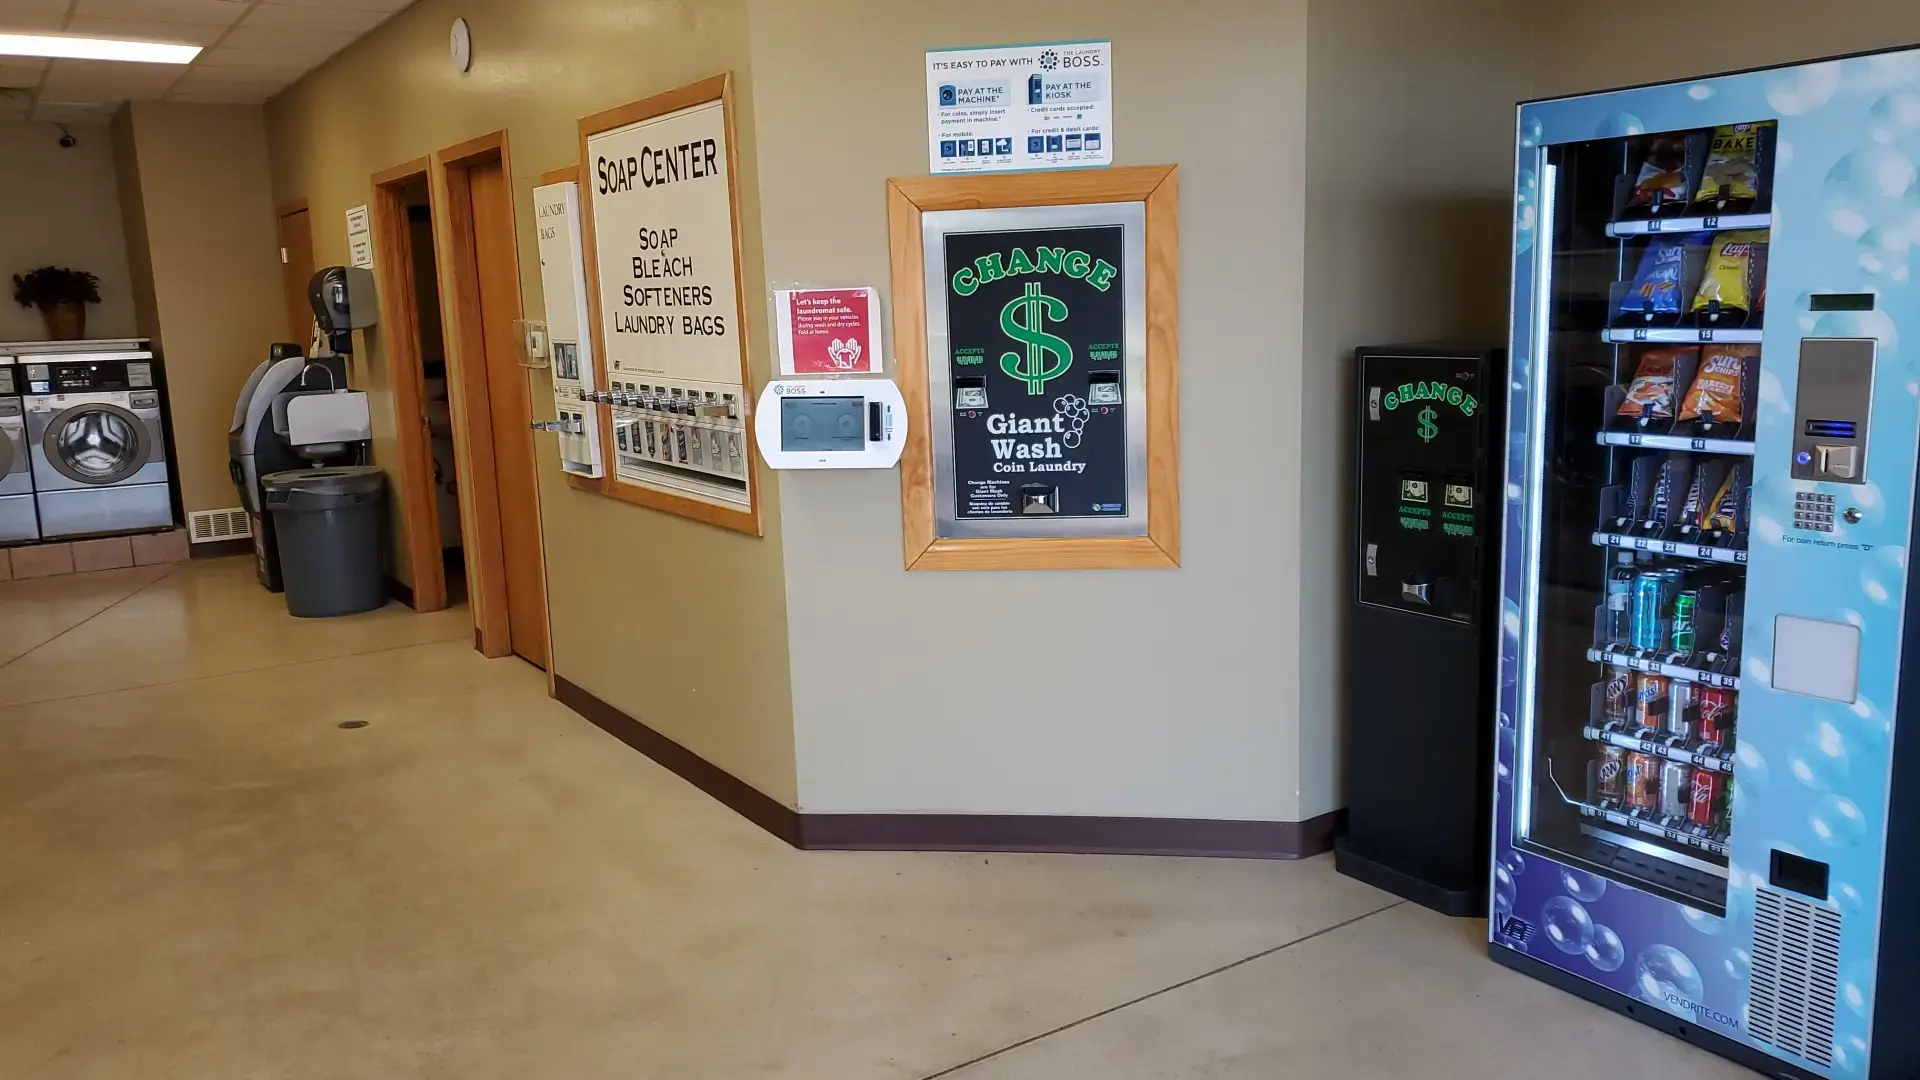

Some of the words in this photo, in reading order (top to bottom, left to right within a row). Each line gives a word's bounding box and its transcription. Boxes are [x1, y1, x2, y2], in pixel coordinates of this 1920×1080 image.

[932, 62, 948, 70] IT'S
[950, 61, 973, 69] EASY
[1009, 58, 1032, 66] WITH
[1063, 56, 1100, 68] BOSS
[1713, 136, 1755, 150] BAKE
[598, 155, 638, 195] SOAP
[640, 138, 718, 188] CENTER
[538, 202, 565, 218] LAUNDRY
[540, 226, 556, 240] BAGS
[639, 228, 678, 250] SOAP
[632, 256, 693, 279] BLEACH
[953, 246, 1117, 296] CHANGE
[623, 285, 712, 306] SOFTENERS
[812, 298, 828, 306] keep
[830, 296, 841, 304] the
[614, 312, 674, 334] LAUNDRY
[683, 316, 725, 336] BAGS
[1384, 381, 1478, 417] CHANGE
[986, 413, 1065, 435] Giant
[991, 437, 1062, 459] Wash
[993, 462, 1025, 473] Coin
[1030, 461, 1086, 473] Laundry
[1399, 506, 1431, 516] ACCEPTS
[1813, 539, 1835, 547] return
[1736, 552, 1747, 560] 25
[1664, 992, 1739, 1030] VENDRITE.COM
